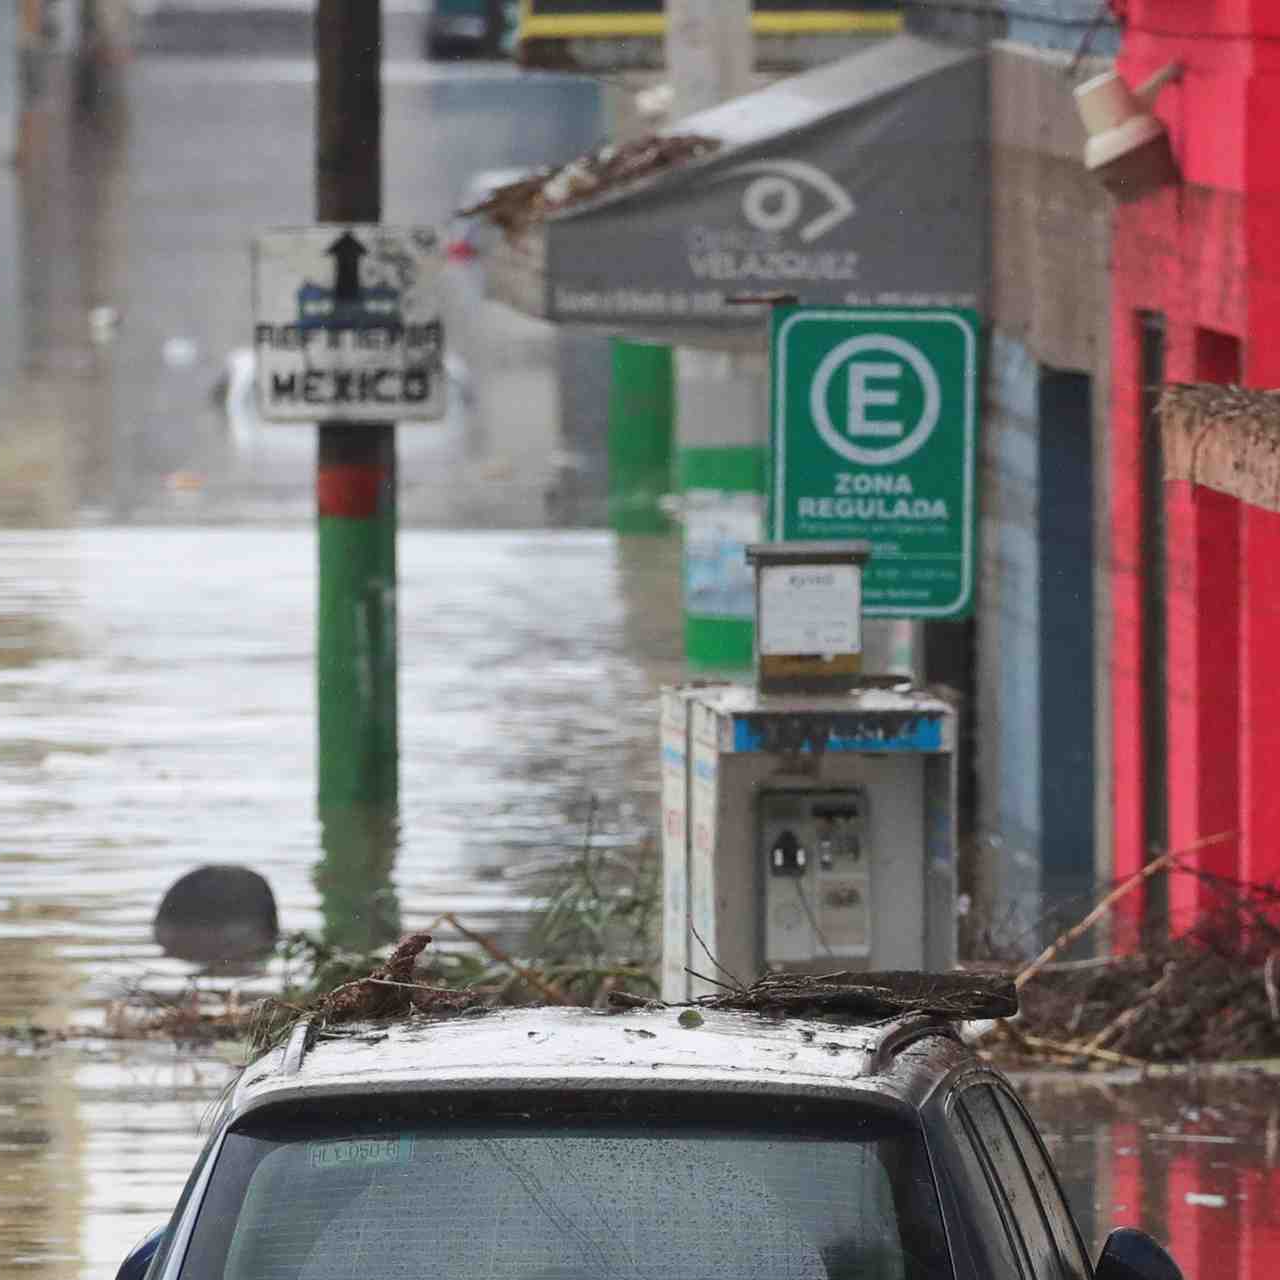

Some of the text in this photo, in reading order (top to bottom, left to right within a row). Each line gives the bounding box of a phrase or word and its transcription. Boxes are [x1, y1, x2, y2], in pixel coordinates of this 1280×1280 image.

[271, 366, 431, 405] MEXICO
[847, 361, 903, 437] E
[834, 473, 913, 494] ZONA
[797, 497, 948, 519] REGULADA
